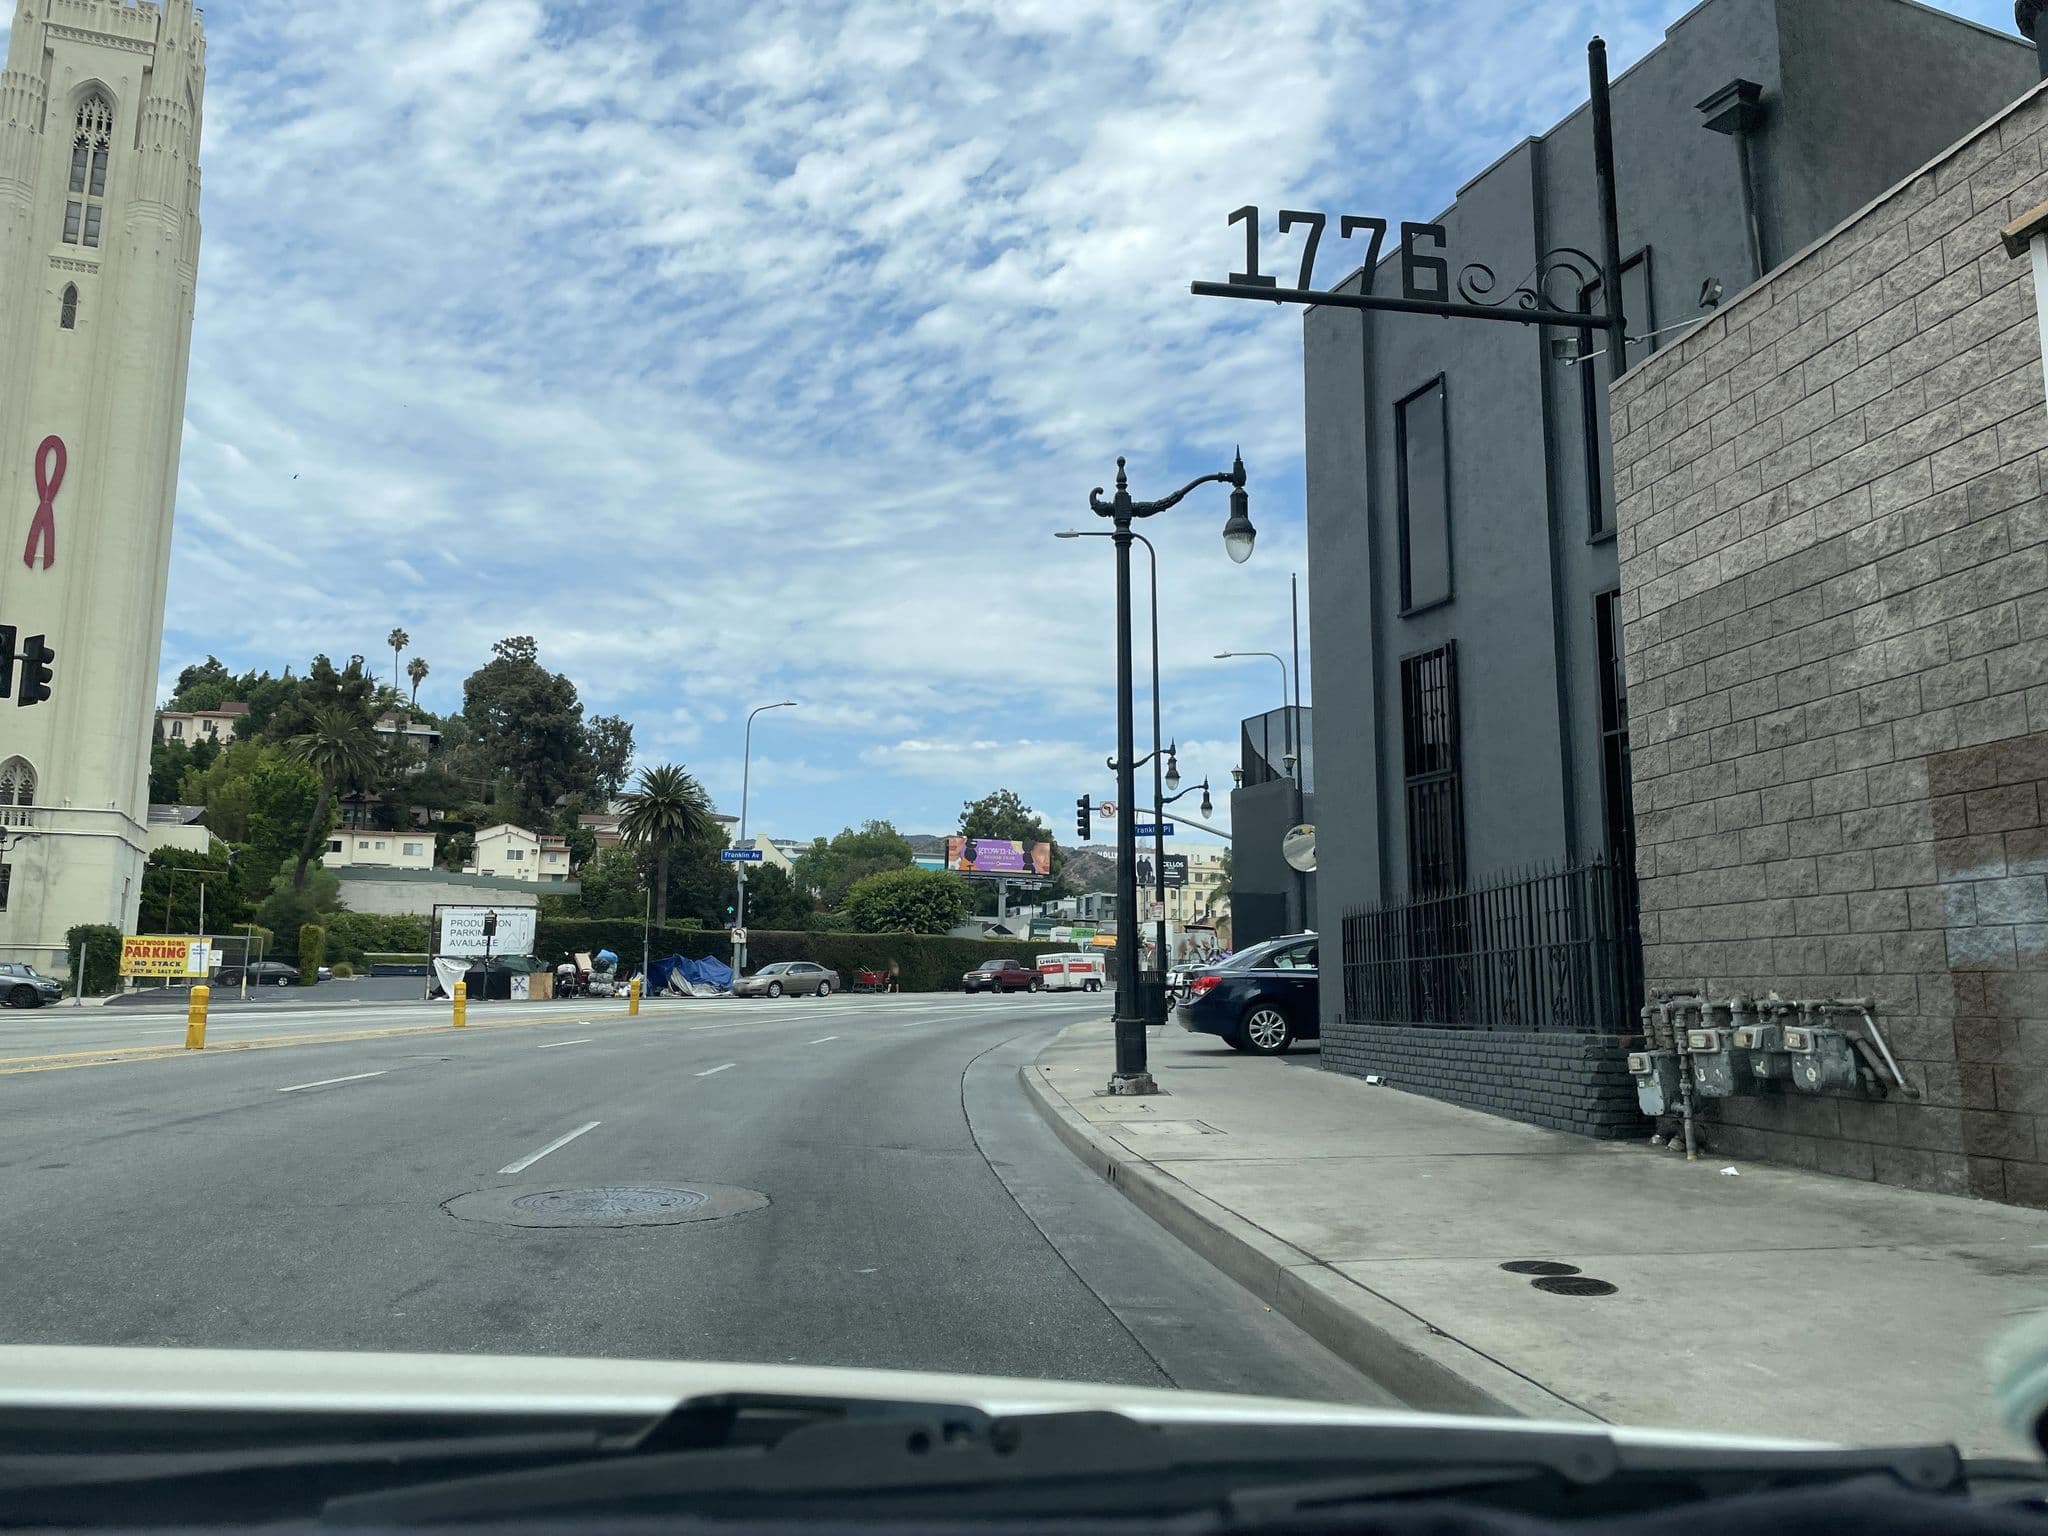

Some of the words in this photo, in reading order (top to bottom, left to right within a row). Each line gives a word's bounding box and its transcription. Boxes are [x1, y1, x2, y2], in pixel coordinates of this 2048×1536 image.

[1228, 205, 1449, 303] 1776
[450, 919, 512, 927] PRODUON
[124, 946, 186, 958] PARKING
